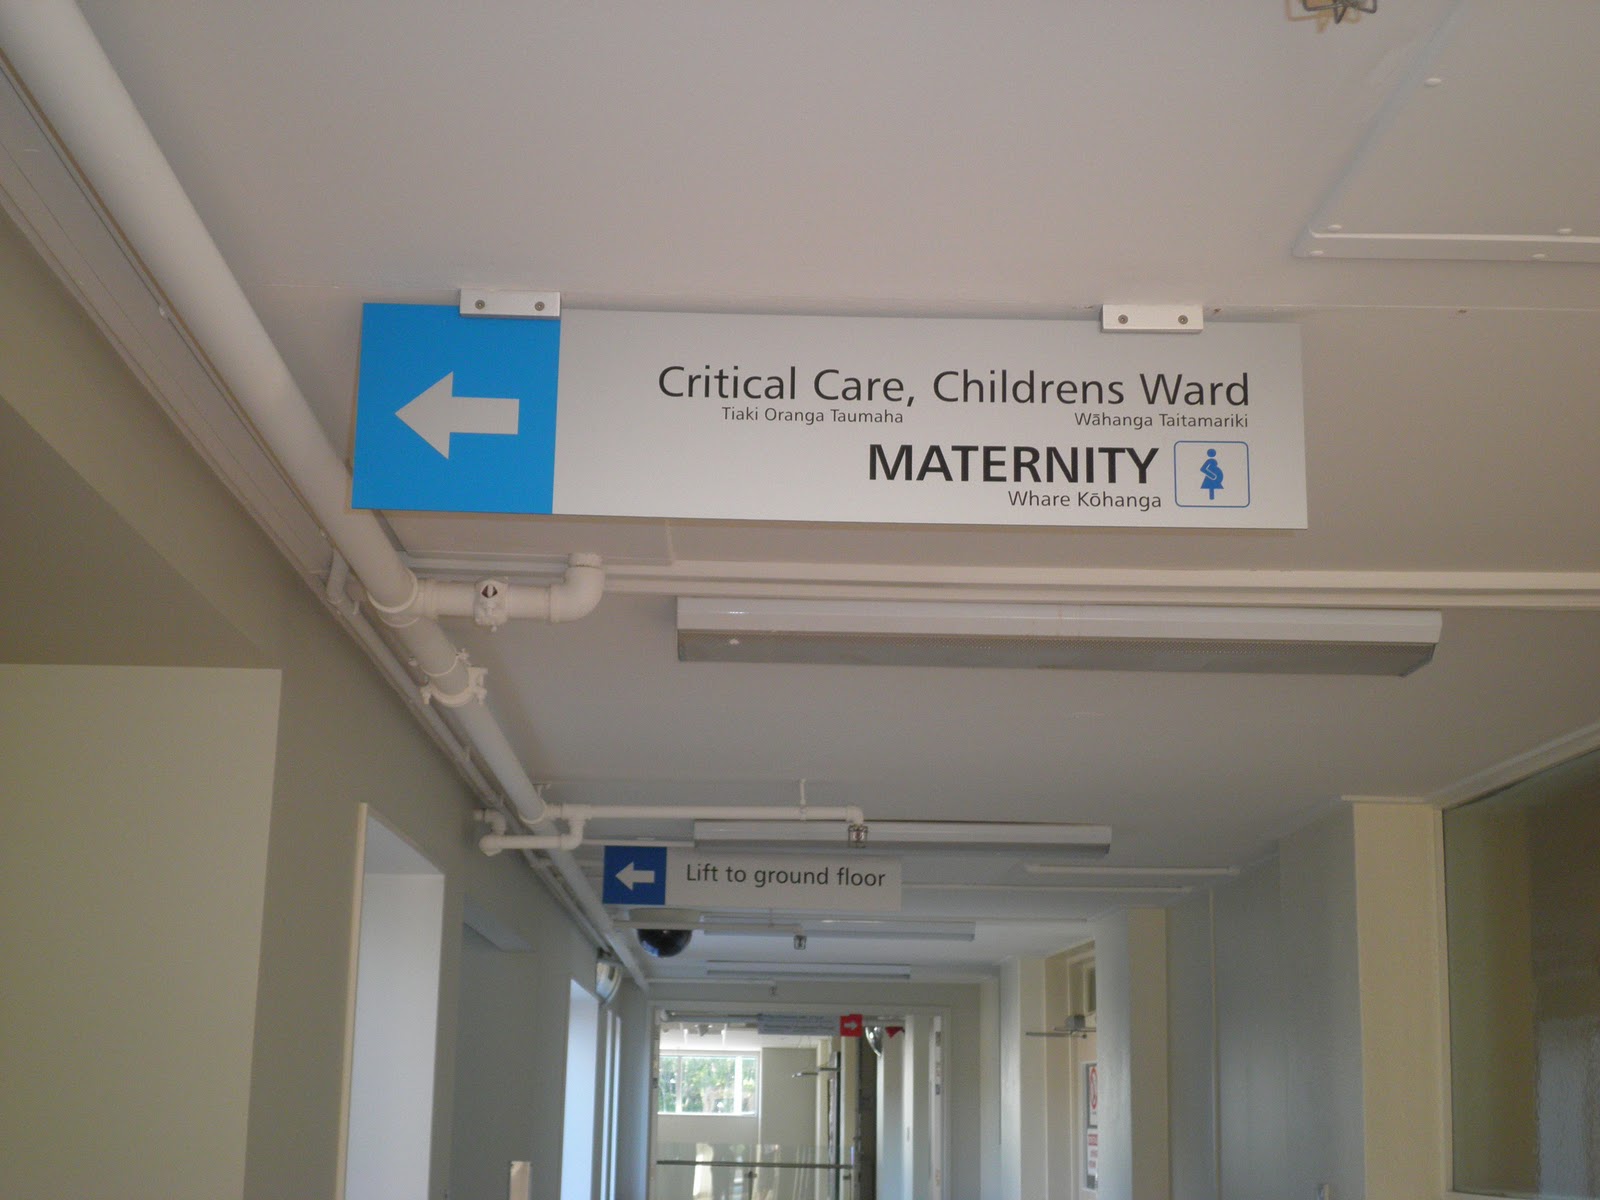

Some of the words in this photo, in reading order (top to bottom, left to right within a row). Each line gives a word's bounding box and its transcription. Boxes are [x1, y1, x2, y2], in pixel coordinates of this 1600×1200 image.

[659, 365, 796, 400] Critical
[814, 369, 915, 408] Care,
[933, 369, 1125, 404] Childrens
[1139, 372, 1249, 407] Ward
[721, 406, 759, 421] Tiaki
[764, 408, 824, 425] Oranga
[830, 408, 903, 424] Taumaha
[1074, 411, 1153, 430] Wāhanga
[1159, 413, 1248, 428] Taitamariki
[869, 443, 1159, 484] MATERNITY
[1007, 489, 1071, 507] Whare
[1077, 490, 1162, 512] Kōhanga
[686, 862, 719, 882] Lift
[725, 865, 747, 883] to
[753, 866, 829, 888] ground
[836, 866, 886, 887] floor
